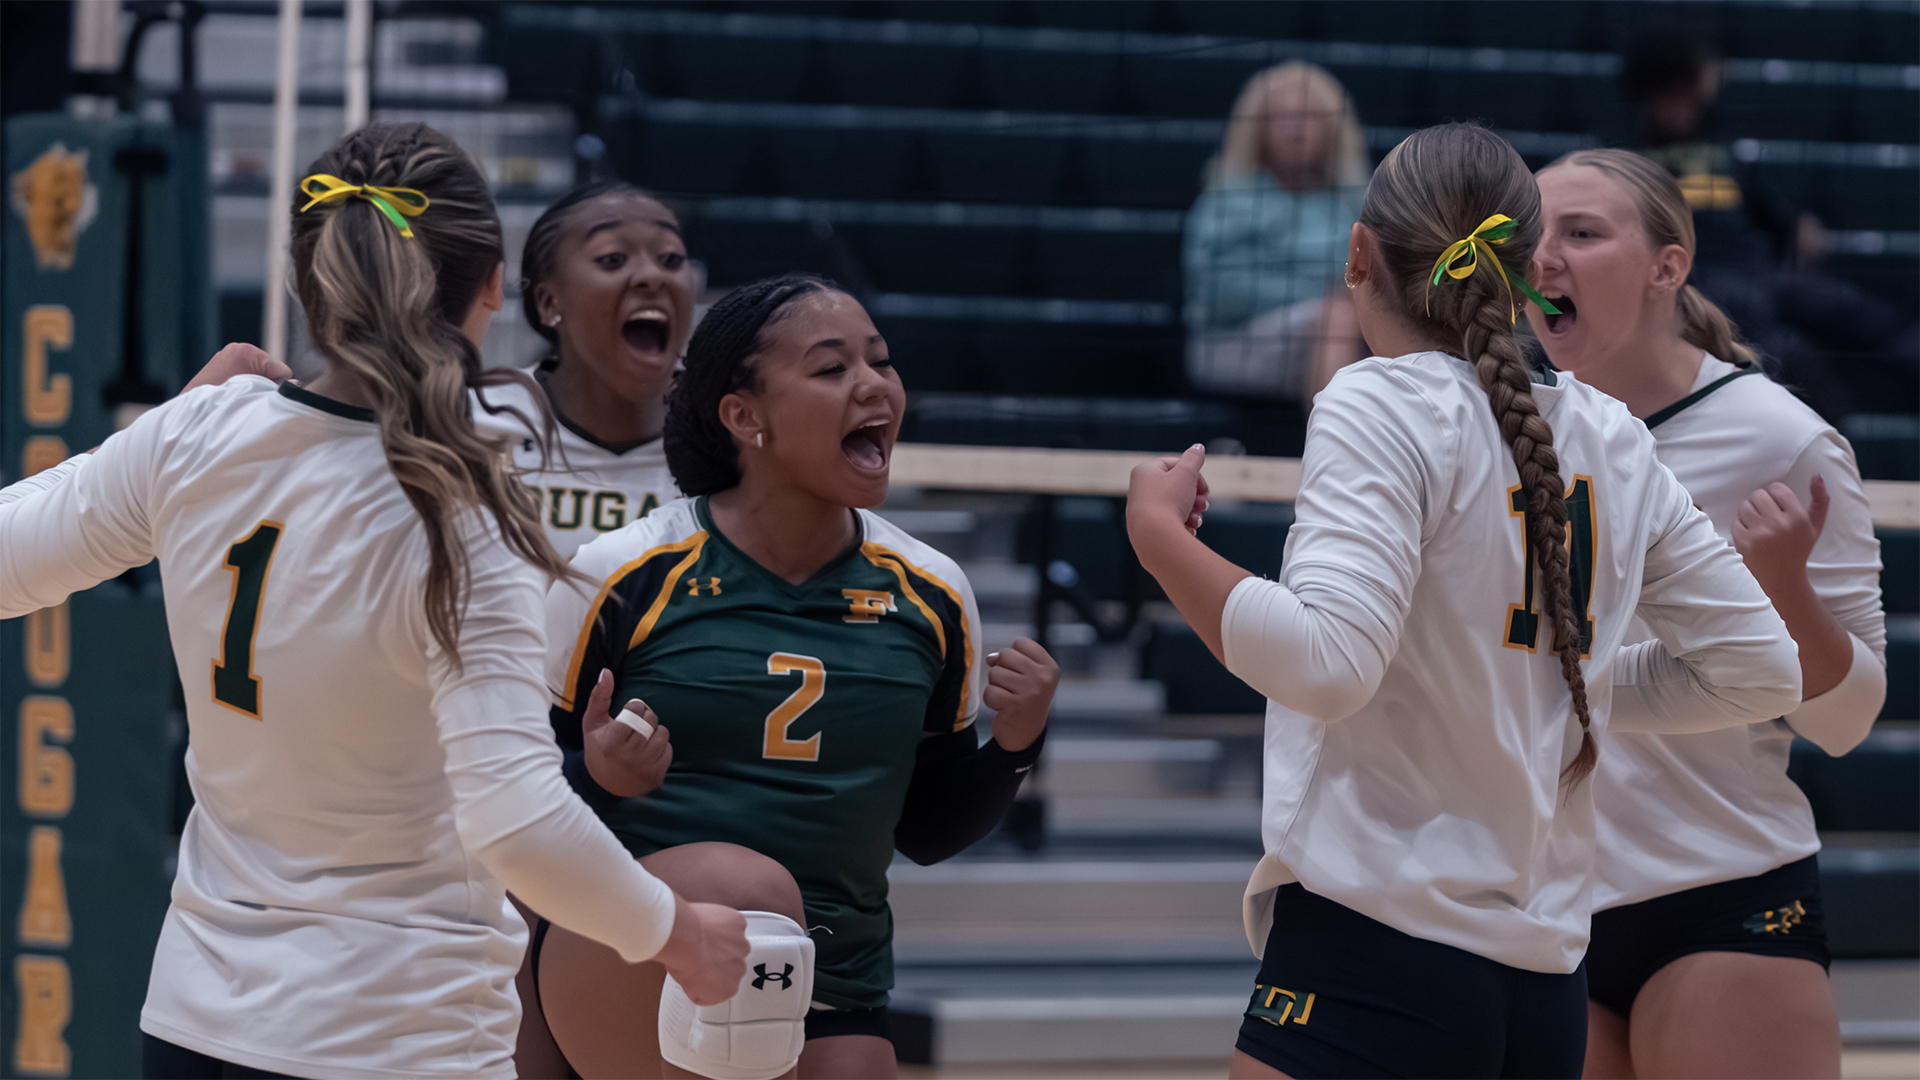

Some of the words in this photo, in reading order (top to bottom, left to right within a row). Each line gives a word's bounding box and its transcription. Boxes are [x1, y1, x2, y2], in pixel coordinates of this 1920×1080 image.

[211, 520, 285, 721] 1
[1502, 473, 1598, 660] 11
[762, 652, 826, 762] 2
